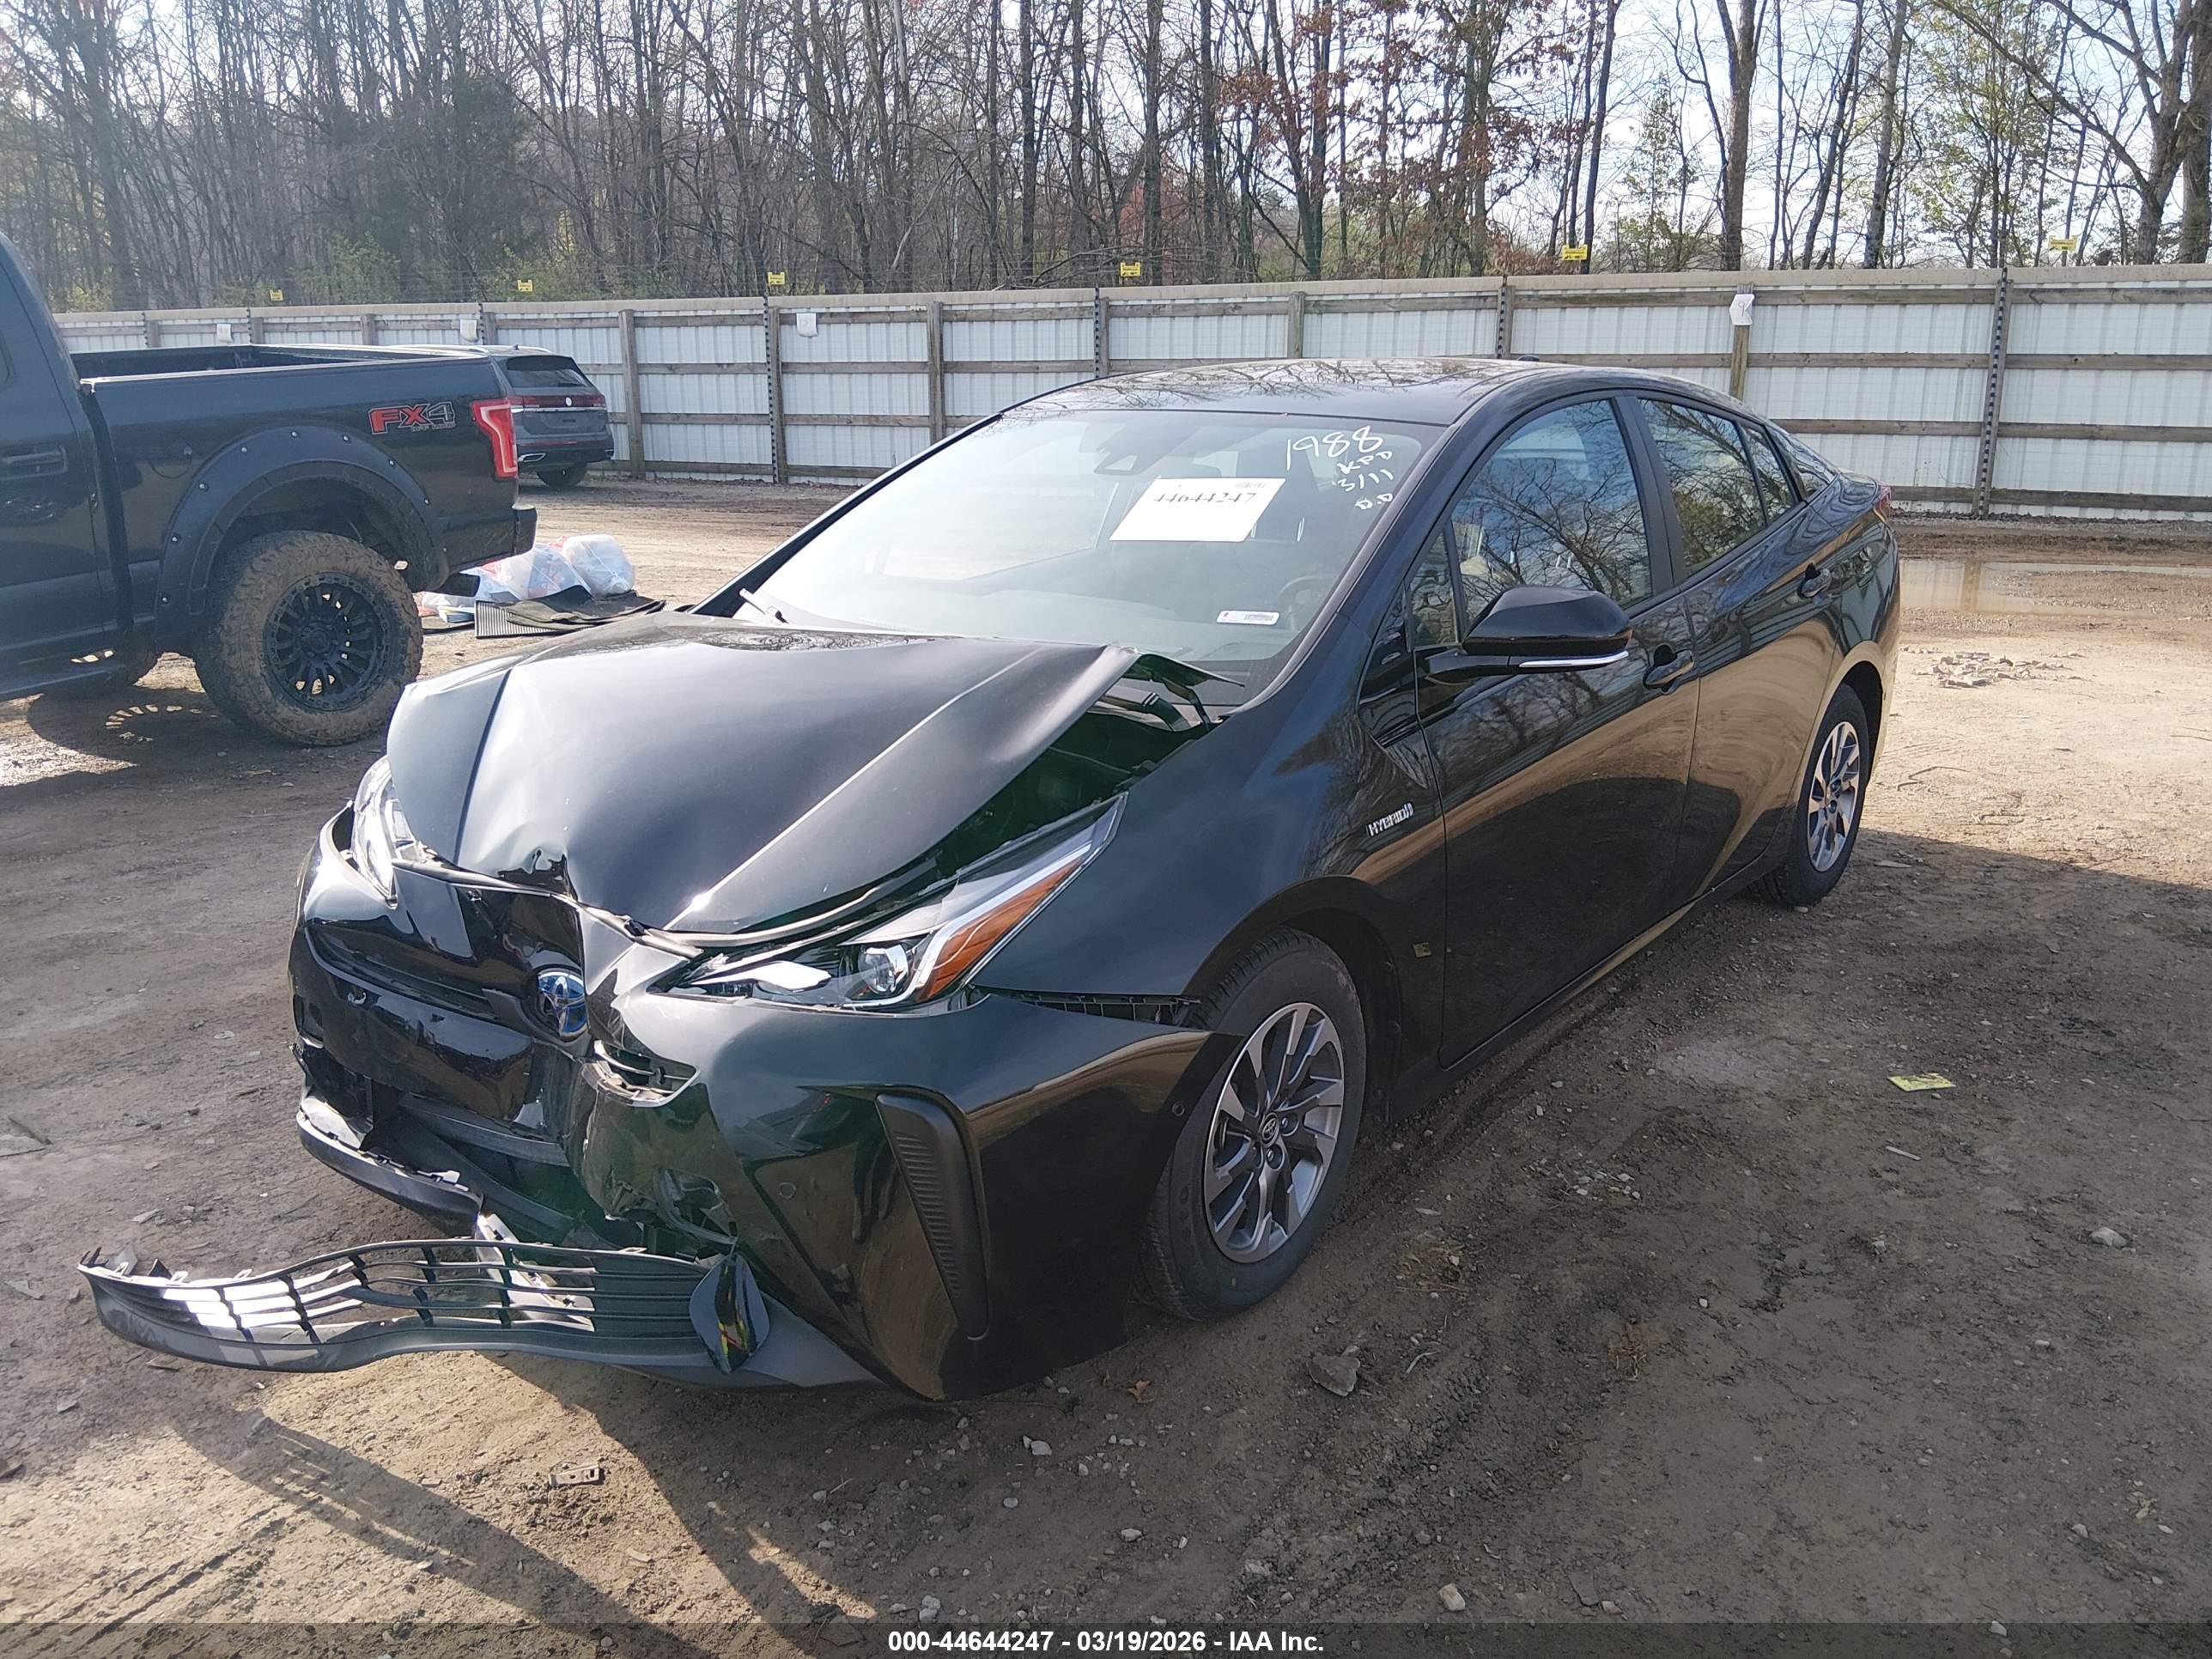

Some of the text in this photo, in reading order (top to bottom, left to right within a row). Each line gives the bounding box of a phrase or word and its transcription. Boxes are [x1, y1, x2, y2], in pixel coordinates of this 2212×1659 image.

[368, 401, 455, 434] FX4
[1286, 425, 1384, 471] 1988
[1368, 807, 1408, 836] HYBRID
